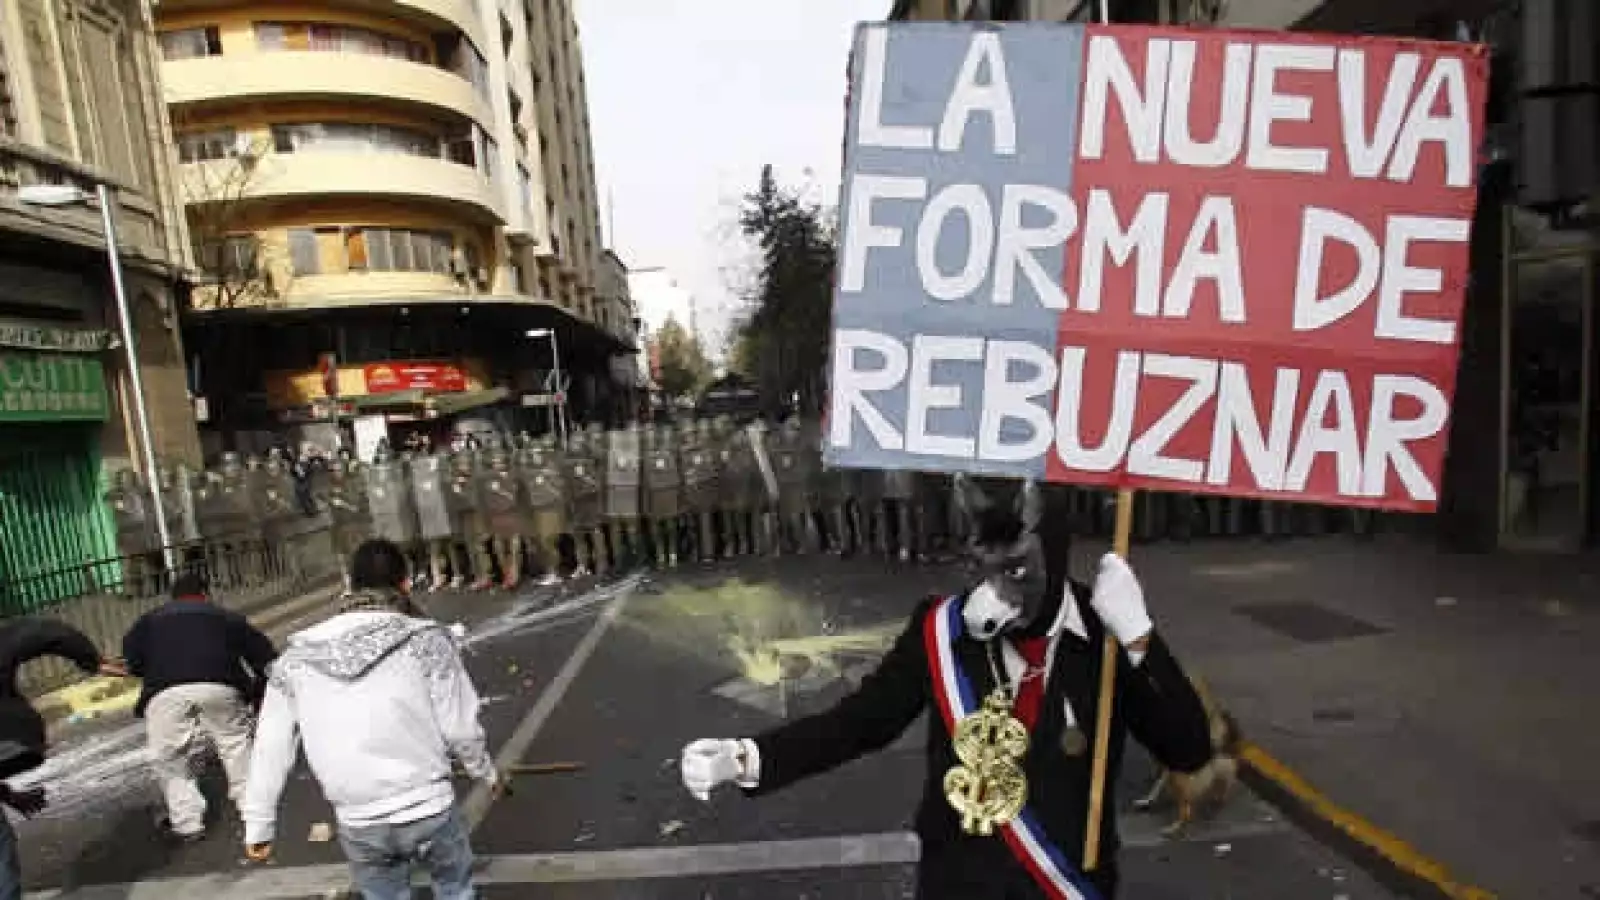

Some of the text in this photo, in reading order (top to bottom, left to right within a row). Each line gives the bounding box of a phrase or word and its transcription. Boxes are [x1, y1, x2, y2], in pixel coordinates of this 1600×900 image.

[858, 28, 1473, 186] LA NUEVA
[841, 175, 1470, 344] FORMA DE
[829, 328, 1449, 501] REBUZNAR
